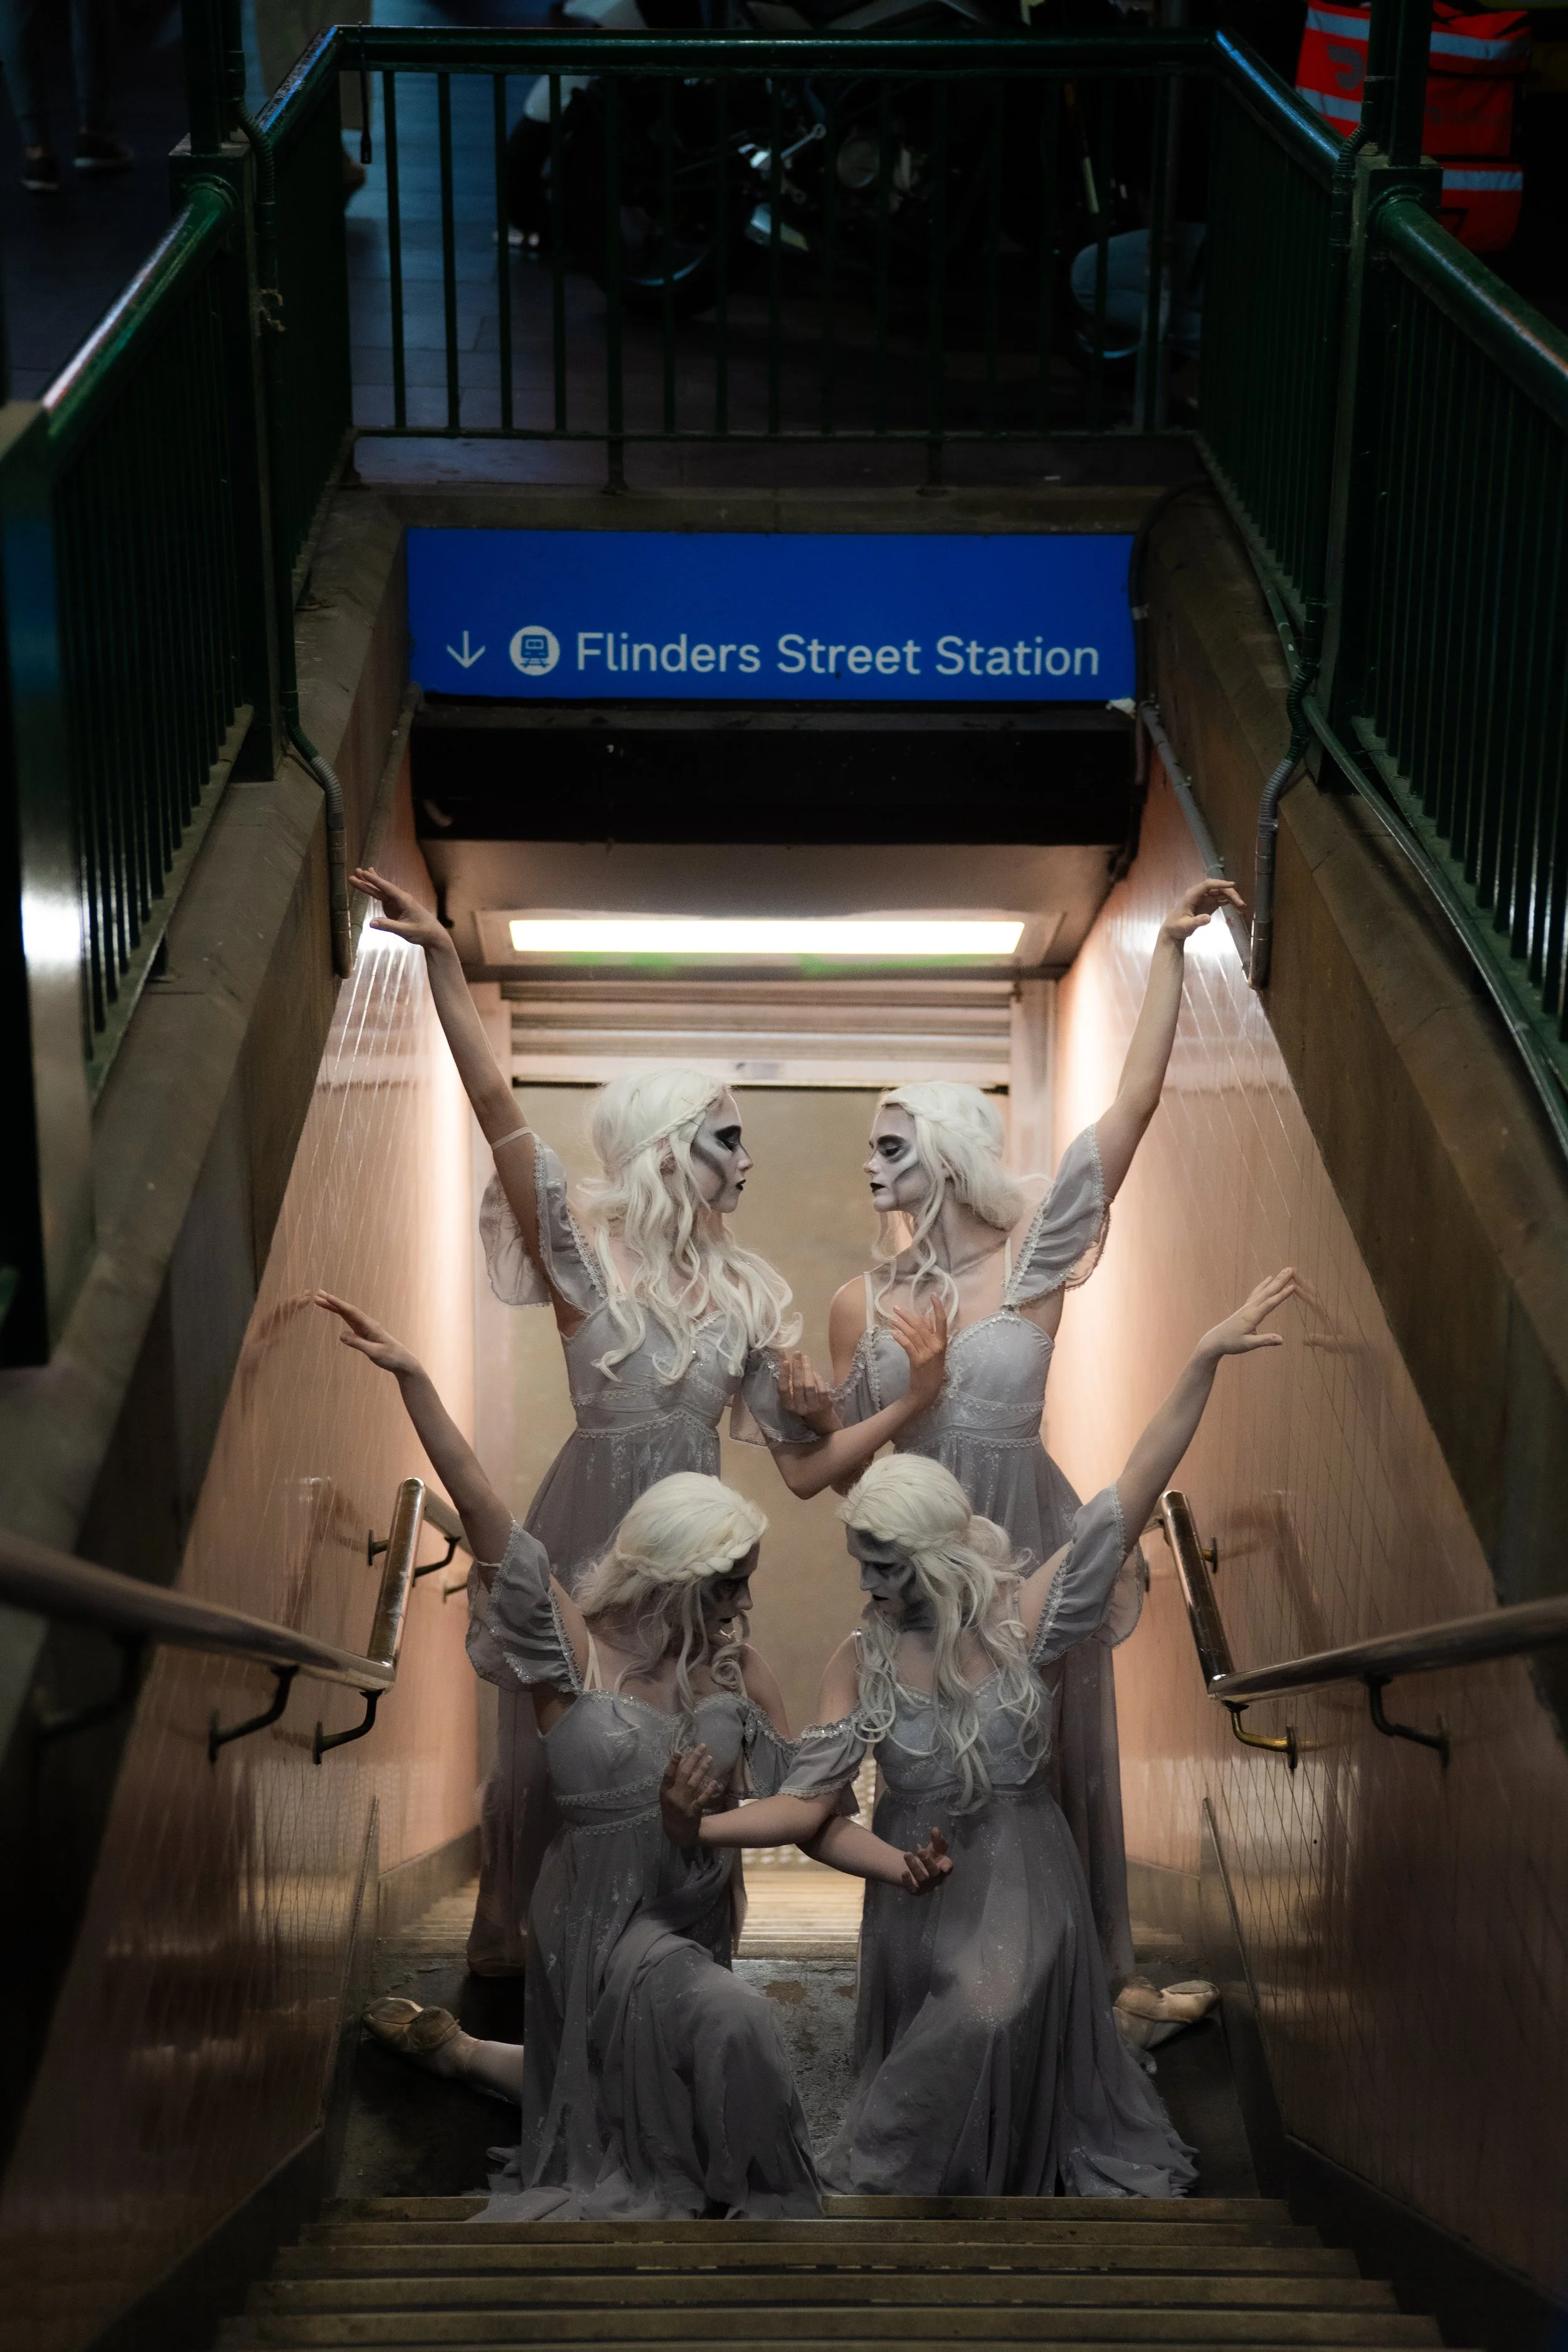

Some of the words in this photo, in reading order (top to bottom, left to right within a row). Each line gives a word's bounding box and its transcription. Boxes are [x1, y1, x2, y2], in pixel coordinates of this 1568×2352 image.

[577, 633, 761, 673] Flinders
[778, 633, 921, 675] Street
[936, 635, 1099, 676] Station
